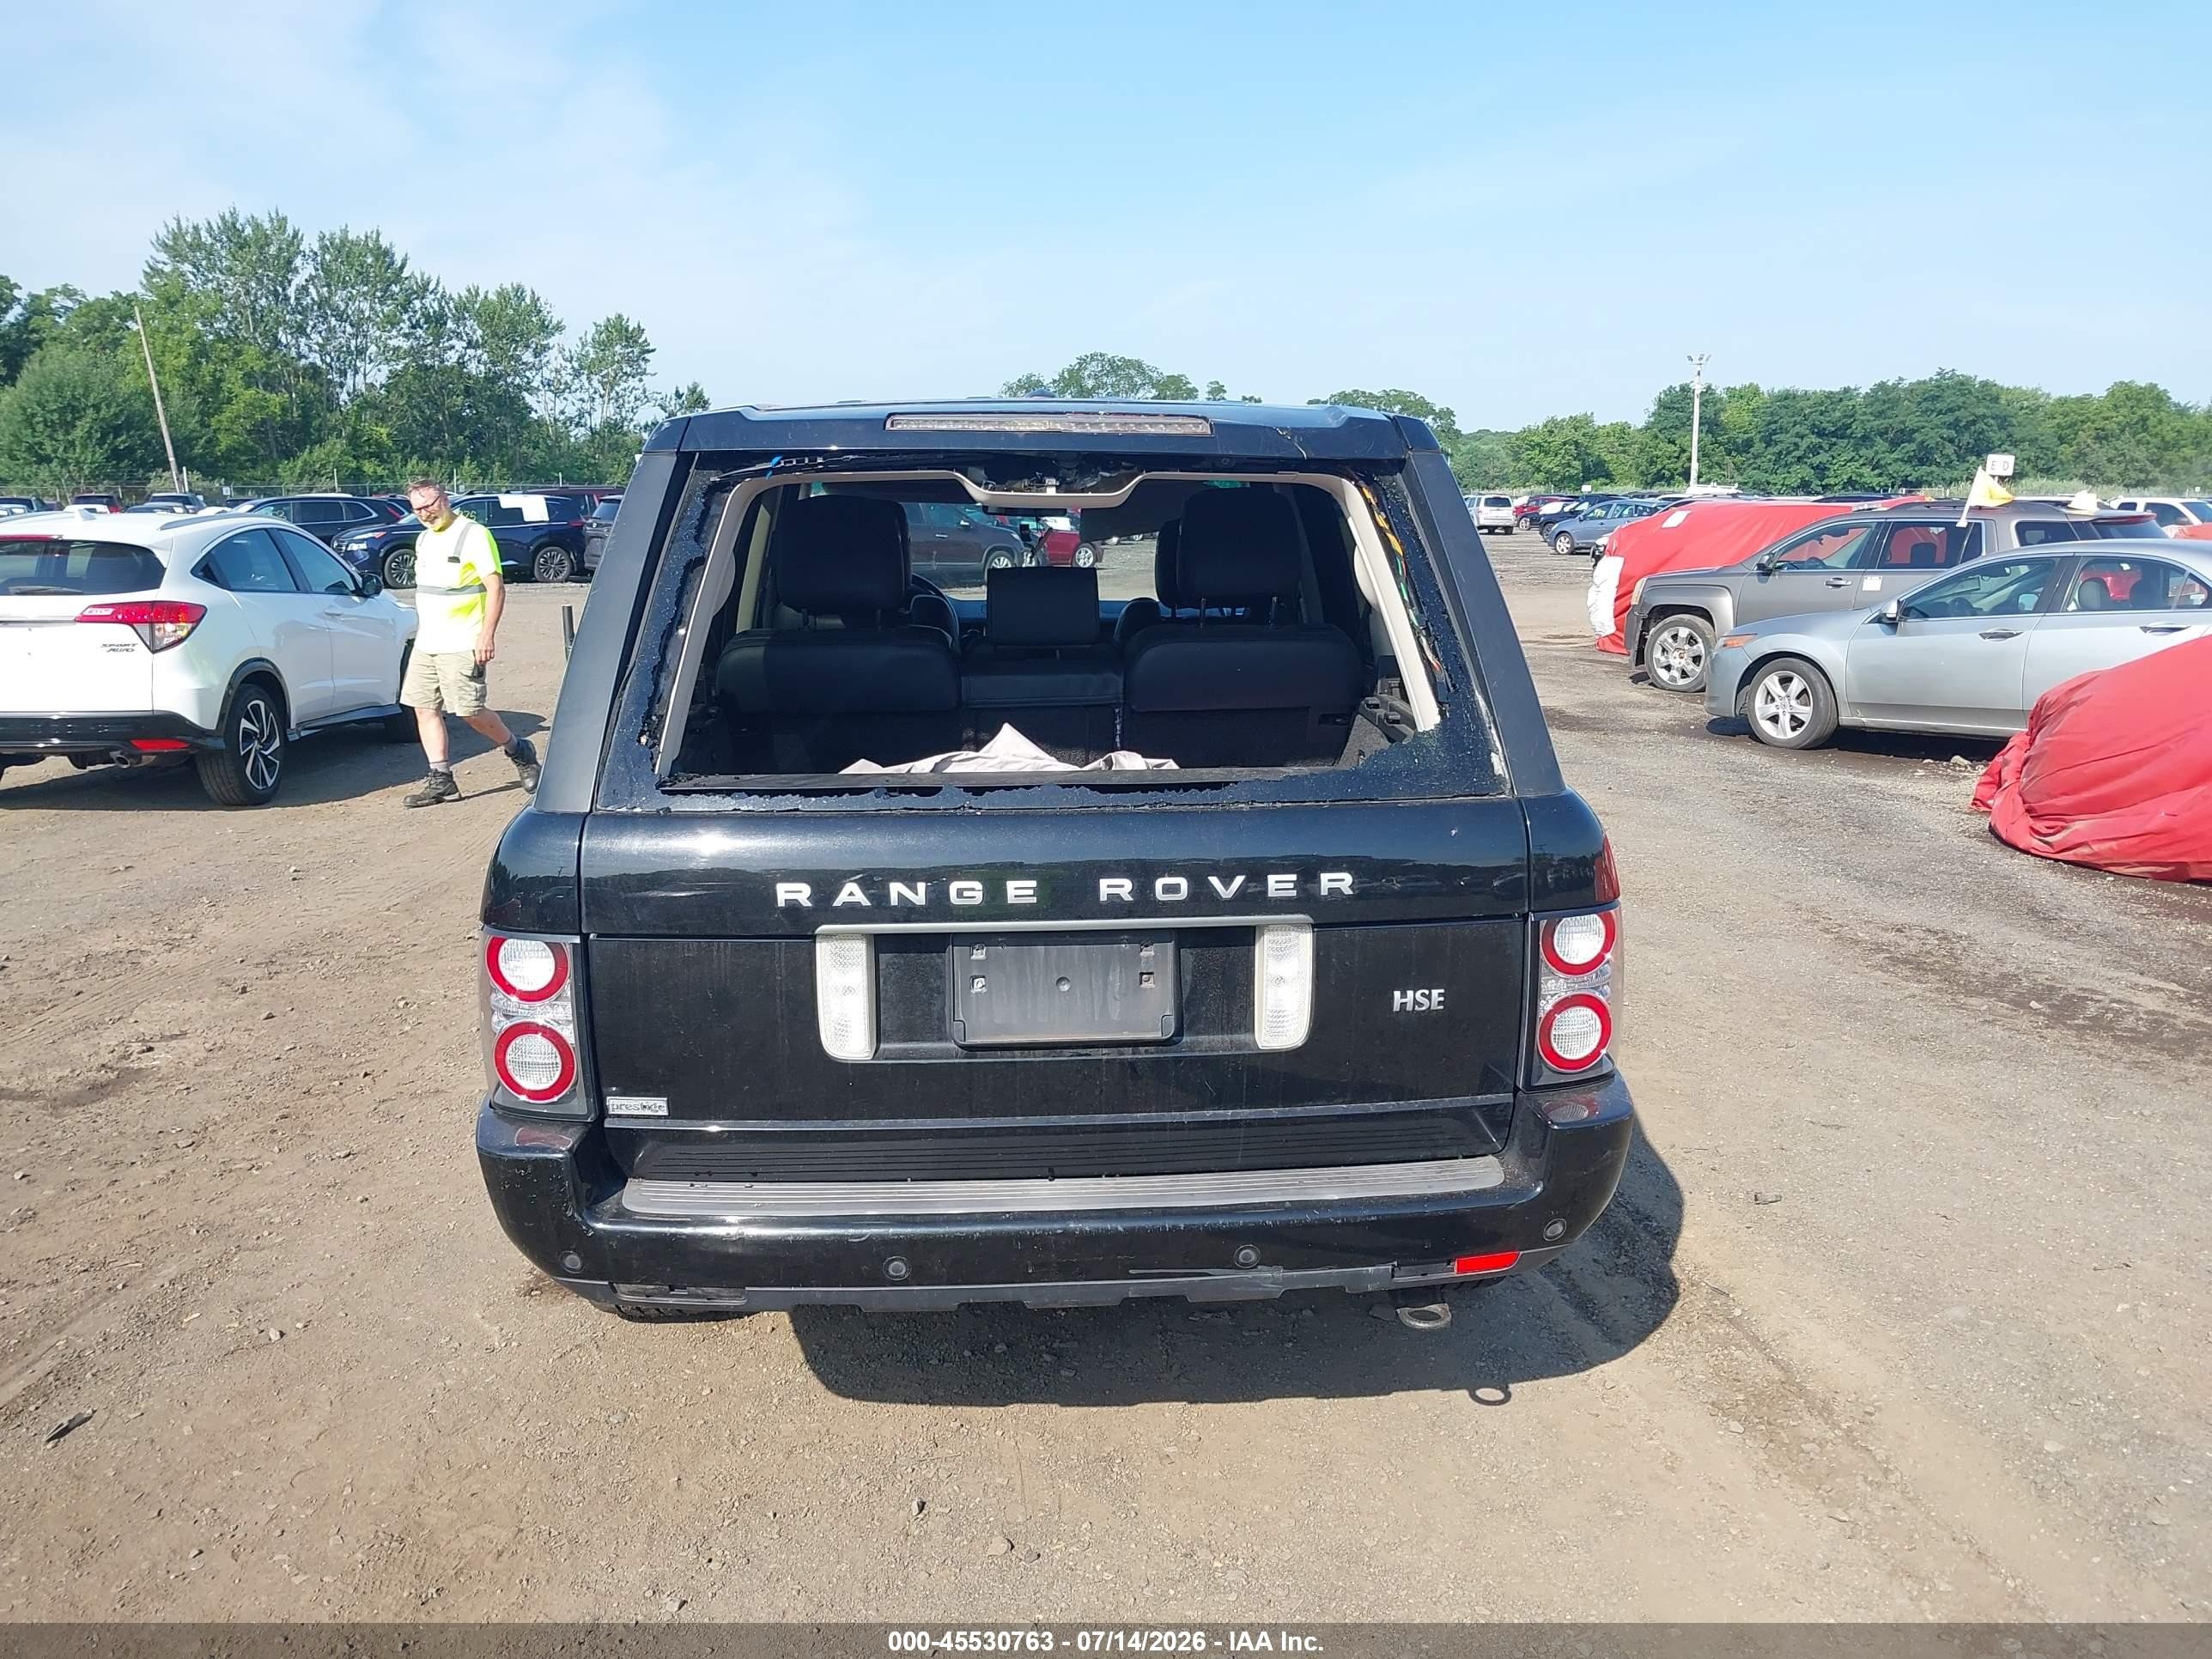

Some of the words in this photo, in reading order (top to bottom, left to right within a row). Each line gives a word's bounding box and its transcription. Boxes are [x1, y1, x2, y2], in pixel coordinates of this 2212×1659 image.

[775, 879, 1038, 908] RANGE
[1099, 872, 1355, 902] ROVER
[1393, 989, 1444, 1012] HSE
